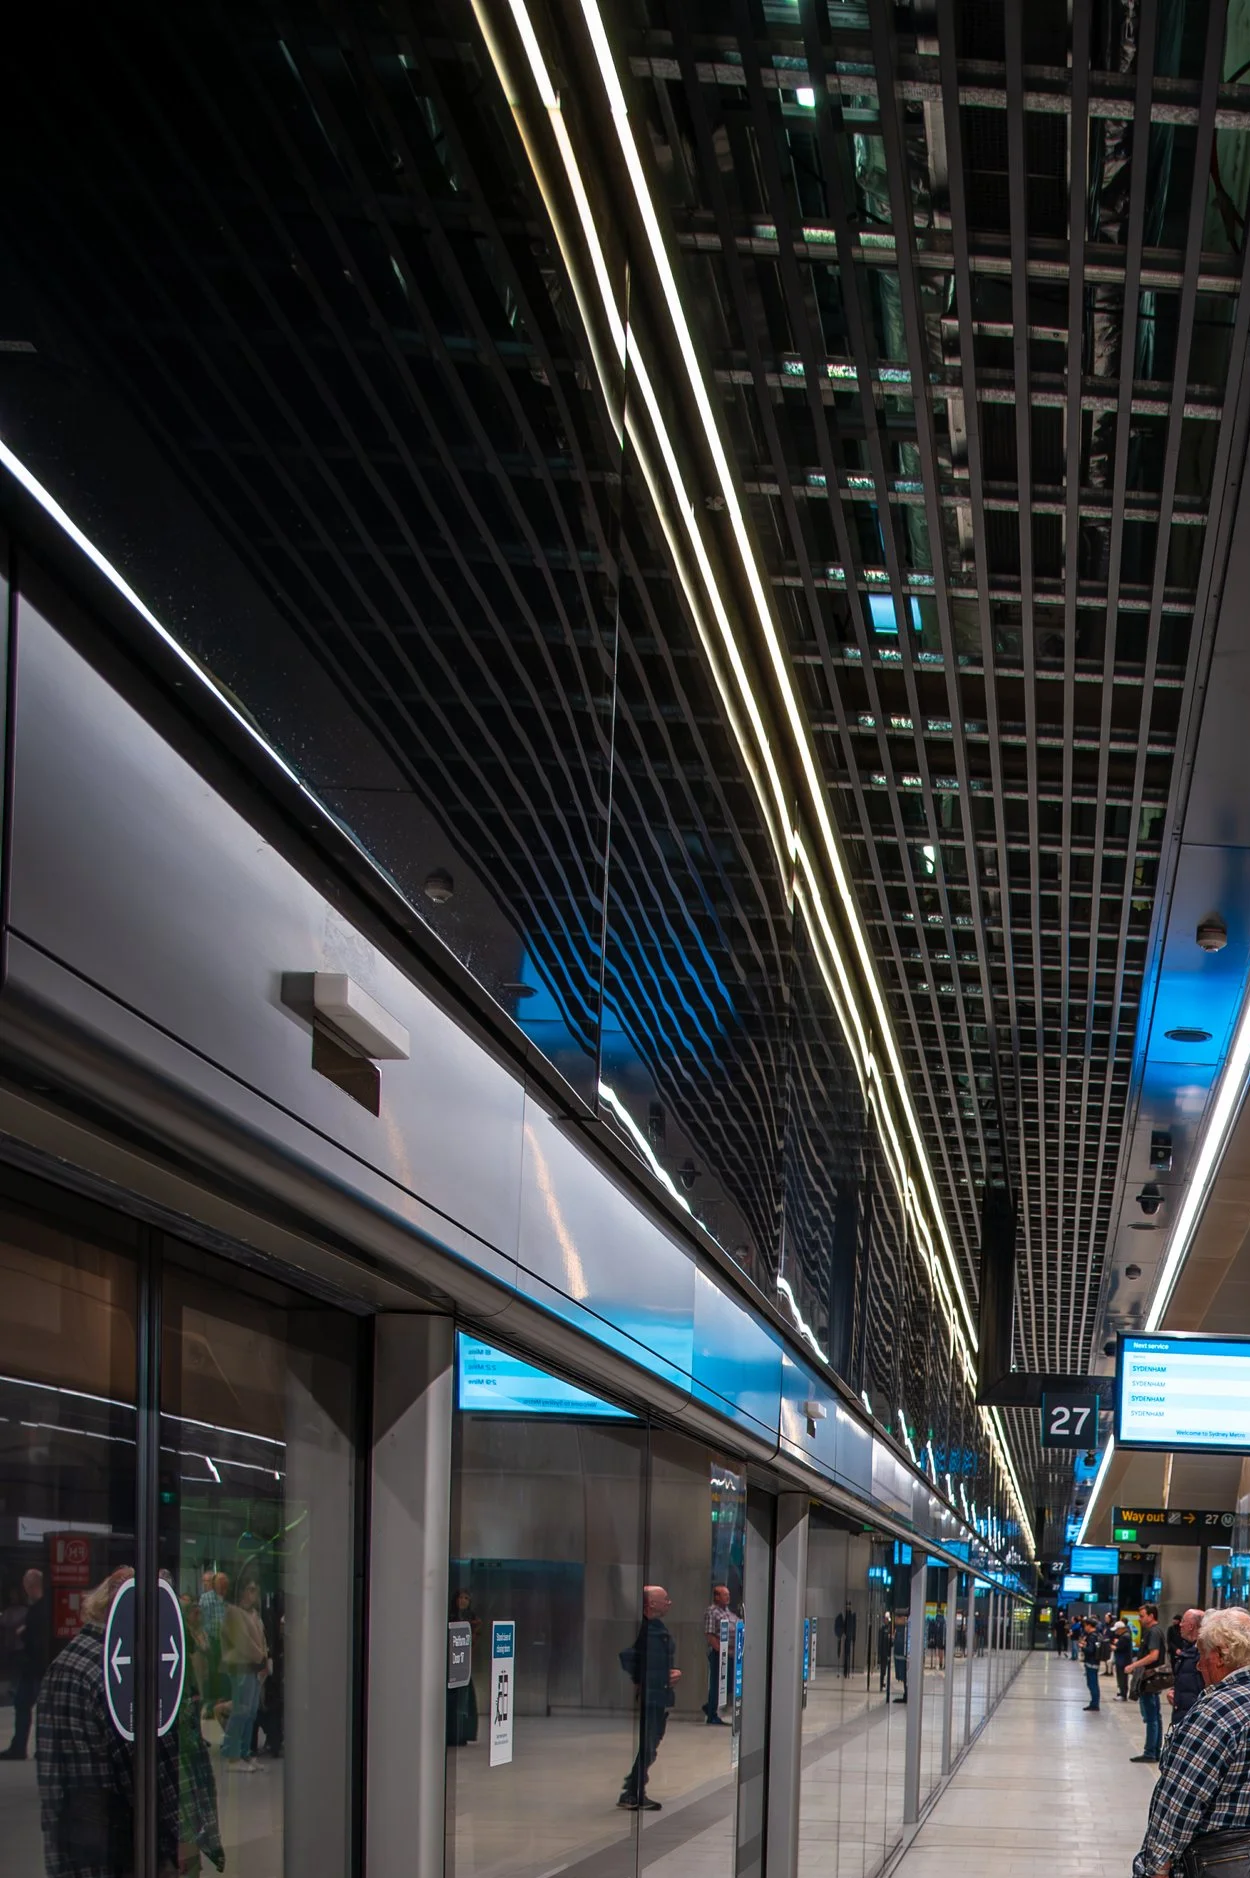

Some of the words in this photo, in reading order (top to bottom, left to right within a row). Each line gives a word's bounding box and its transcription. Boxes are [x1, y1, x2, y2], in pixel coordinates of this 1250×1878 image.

[1132, 1365, 1167, 1373] SYDENHAM
[1131, 1380, 1166, 1388] SYDENHAM
[1050, 1406, 1091, 1435] 27
[1176, 1429, 1201, 1437] Welcome
[1208, 1431, 1228, 1439] Sydney
[1121, 1510, 1144, 1524] Way
[1146, 1513, 1165, 1523] out
[1204, 1514, 1219, 1525] 27
[1052, 1562, 1064, 1571] 27
